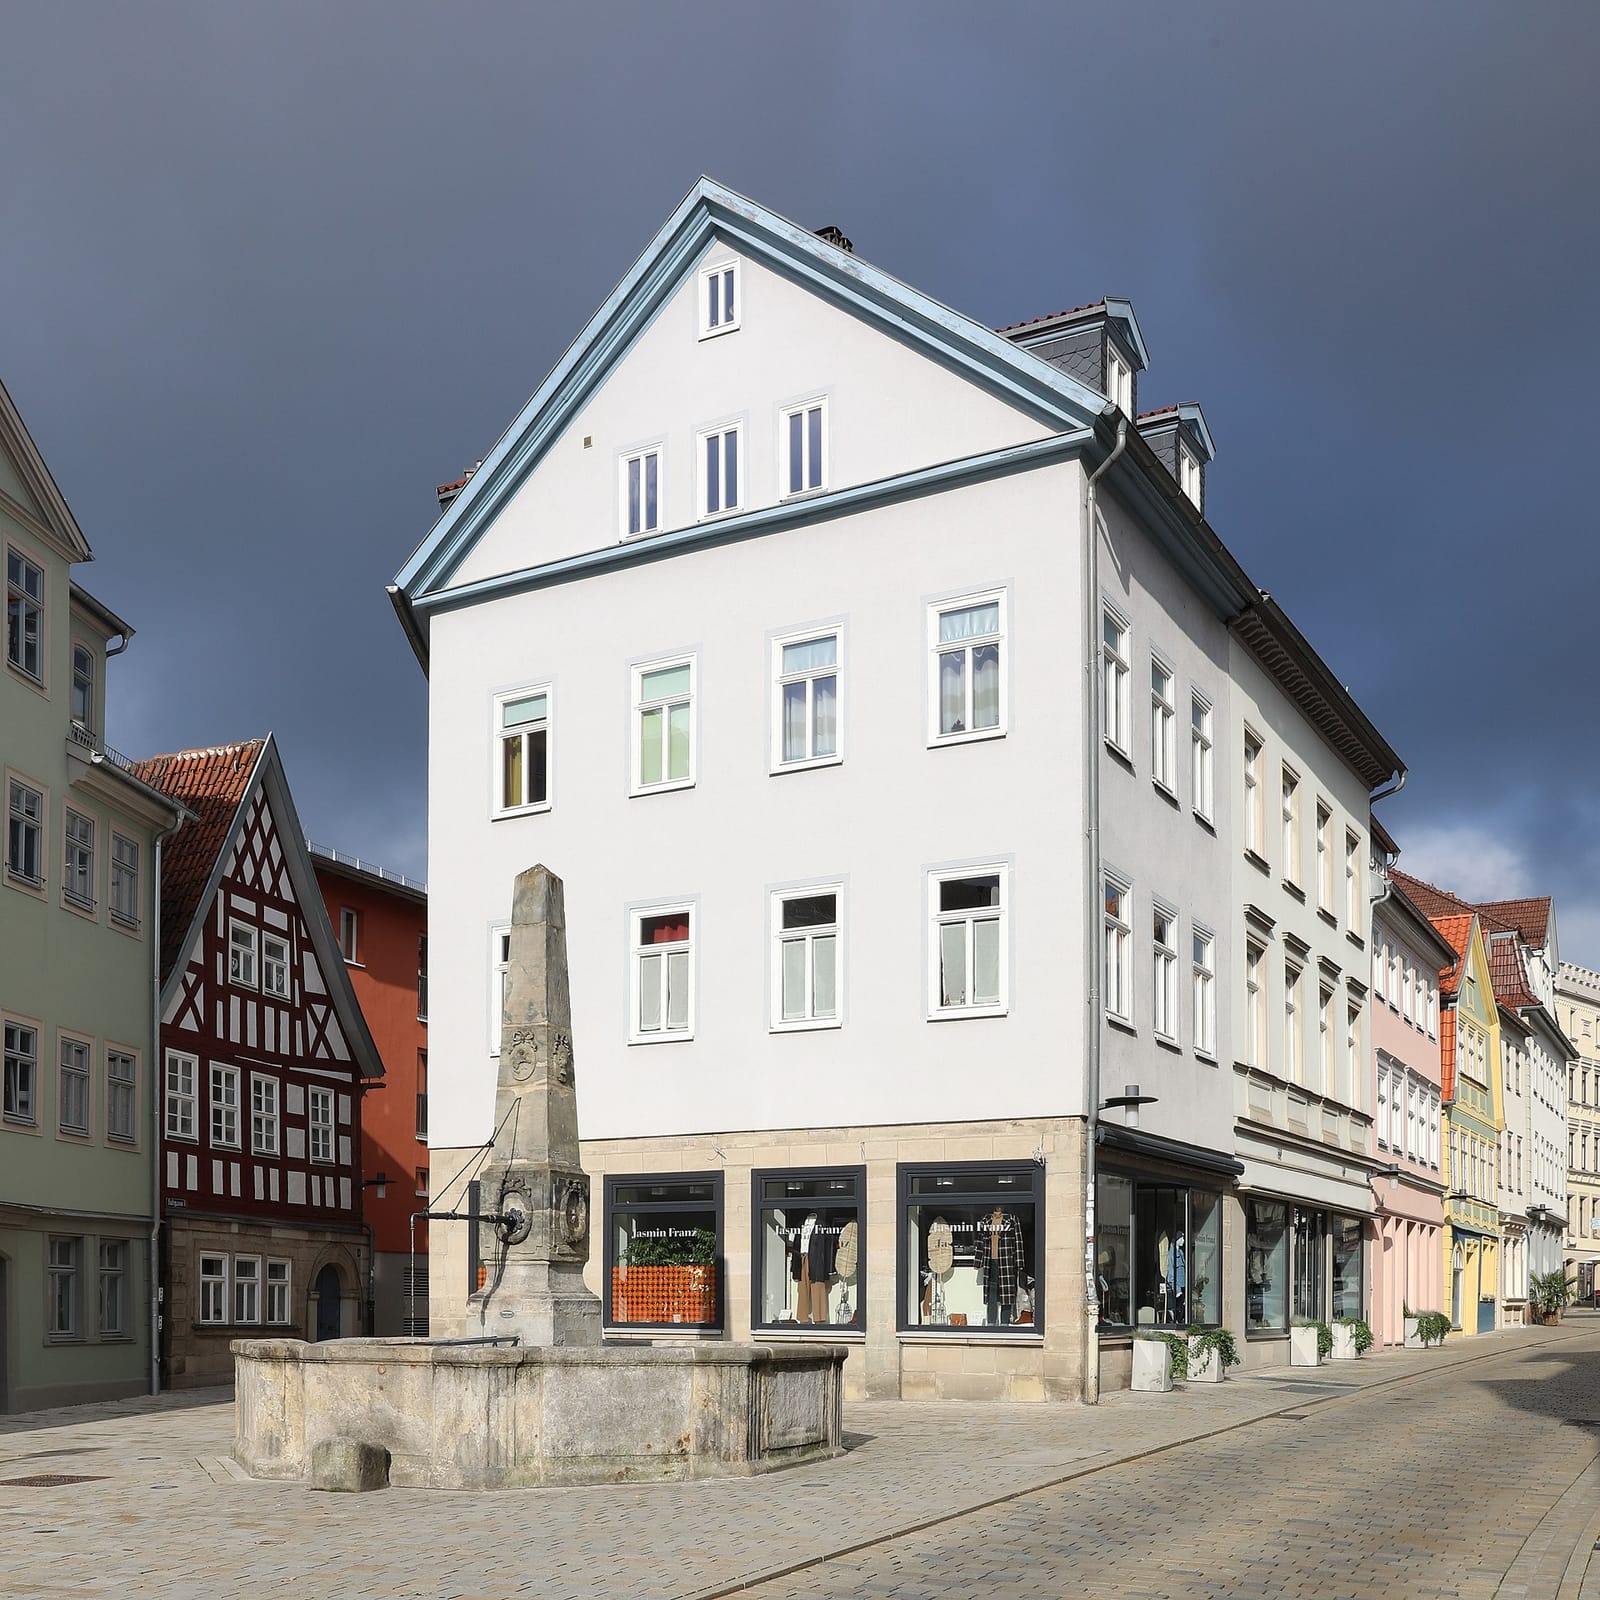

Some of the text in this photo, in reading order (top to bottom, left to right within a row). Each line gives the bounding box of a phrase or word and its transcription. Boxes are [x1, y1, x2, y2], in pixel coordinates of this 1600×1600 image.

[775, 1225, 812, 1235] Jasmi
[977, 1221, 1011, 1232] Franz
[631, 1227, 697, 1239] Jasmin Franz
